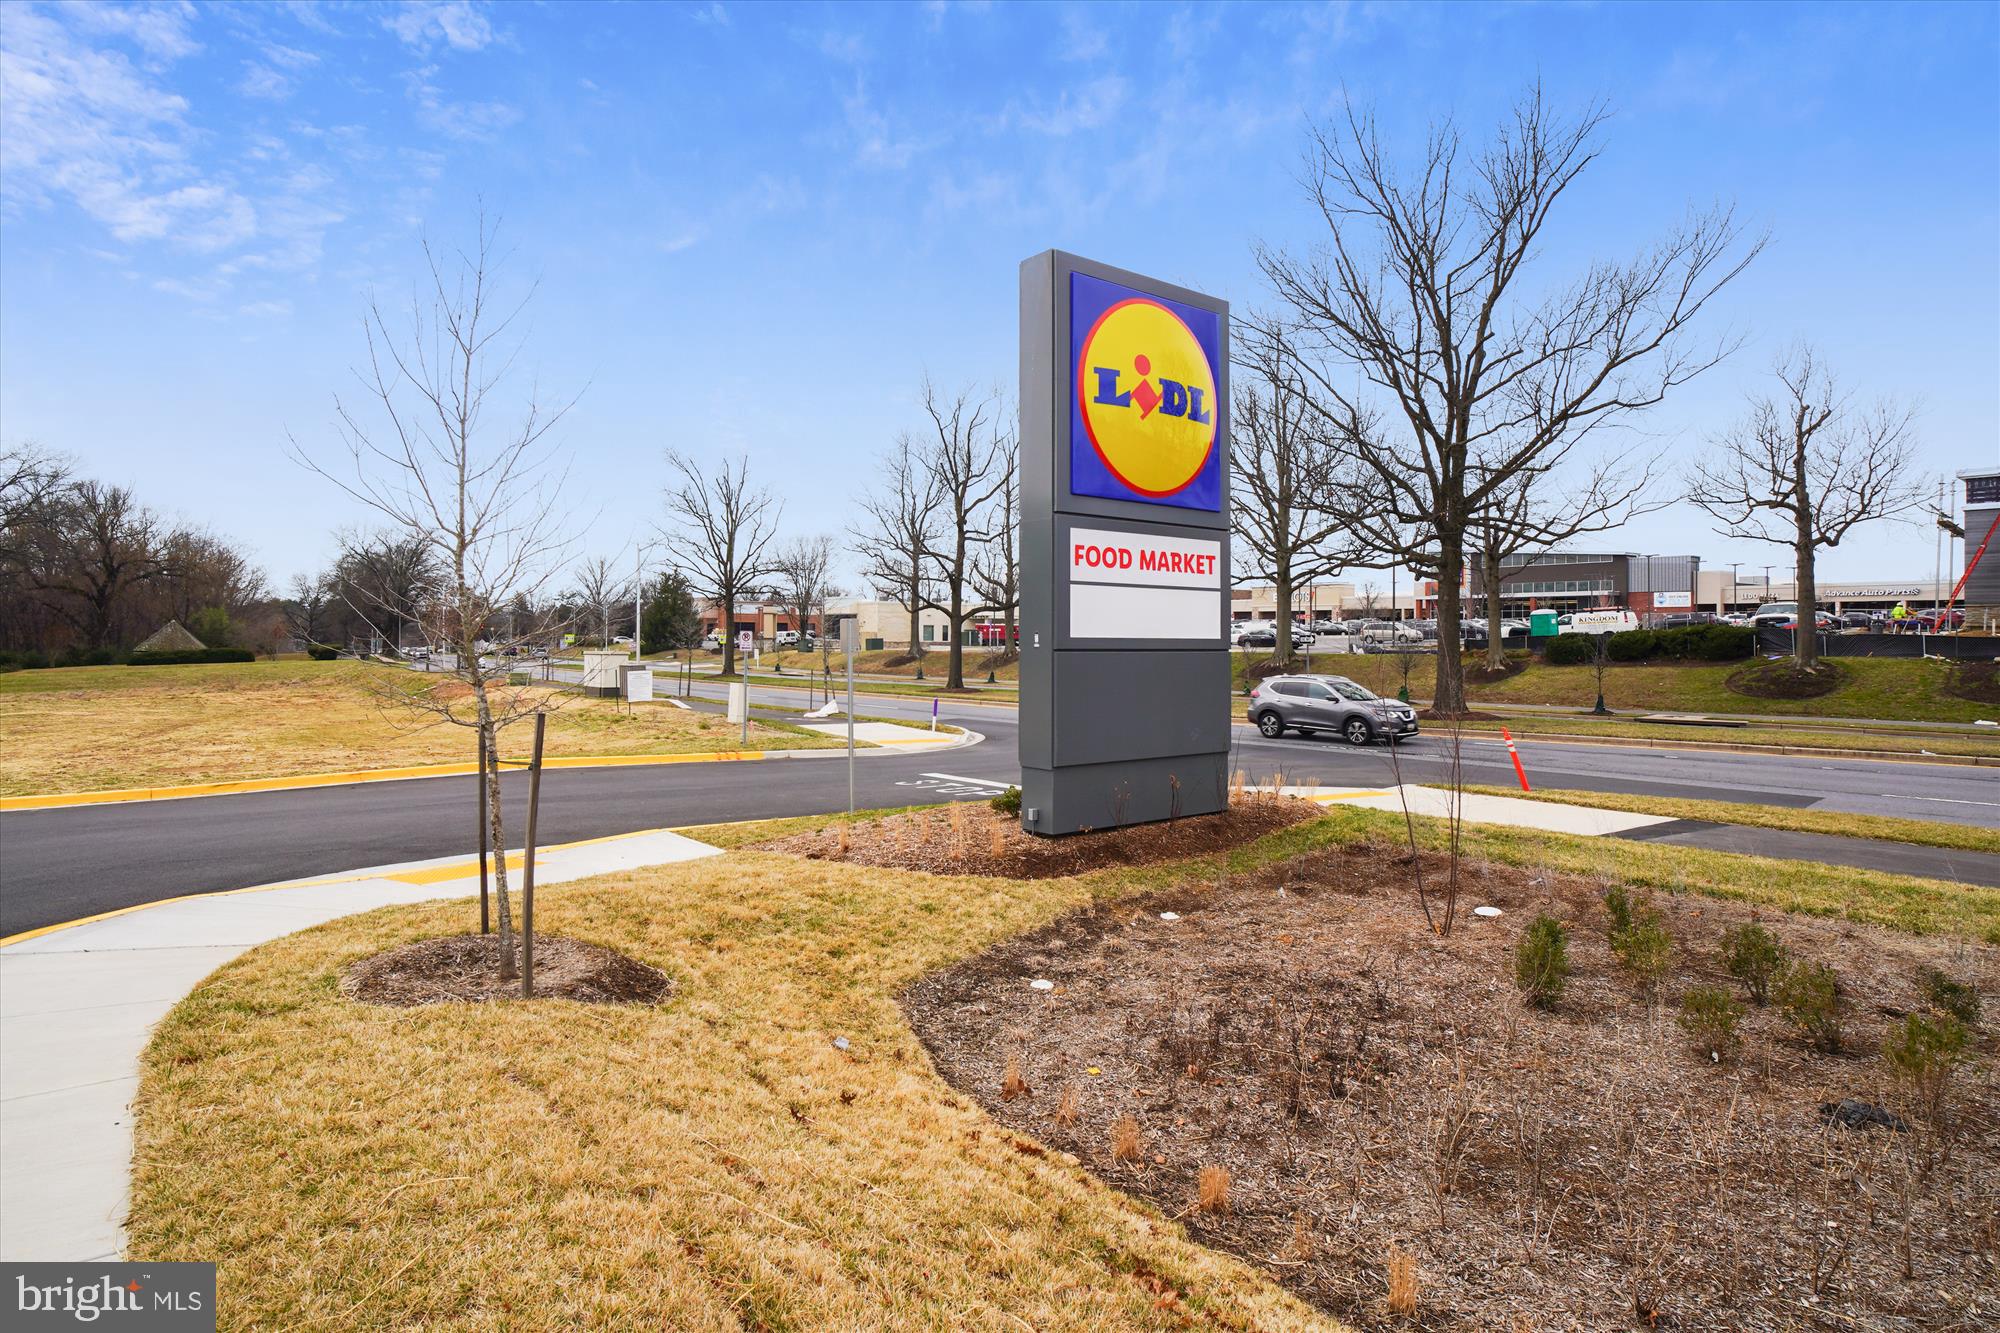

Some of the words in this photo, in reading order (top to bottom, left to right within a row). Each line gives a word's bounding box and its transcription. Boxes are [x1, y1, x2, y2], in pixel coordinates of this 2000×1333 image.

[1074, 544, 1133, 570] FOOD
[1139, 549, 1216, 576] MARKET
[1885, 588, 1910, 596] Parts
[1579, 615, 1618, 623] KINGDOM
[894, 780, 1006, 796] STOP
